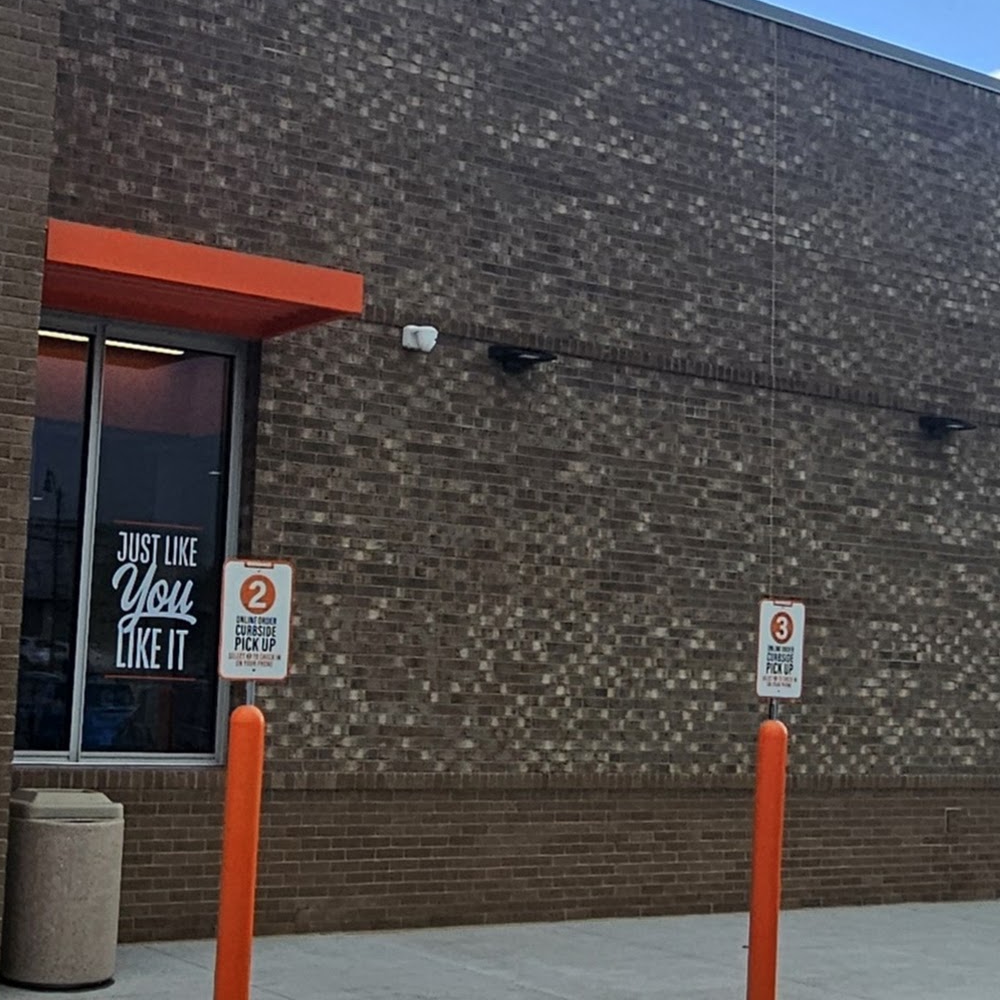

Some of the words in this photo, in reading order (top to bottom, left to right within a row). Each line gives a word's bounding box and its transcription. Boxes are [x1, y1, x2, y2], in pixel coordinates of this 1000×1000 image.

[117, 531, 160, 565] JUST
[165, 535, 198, 567] LIKE
[112, 562, 197, 633] You
[248, 580, 267, 609] 2
[235, 624, 277, 638] CURBSIDE
[775, 616, 789, 640] 3
[116, 626, 162, 669] LIKE
[168, 630, 189, 671] IT
[234, 637, 259, 652] PICK
[261, 638, 277, 652] UP
[766, 662, 782, 674] PICK
[783, 663, 795, 676] UP
